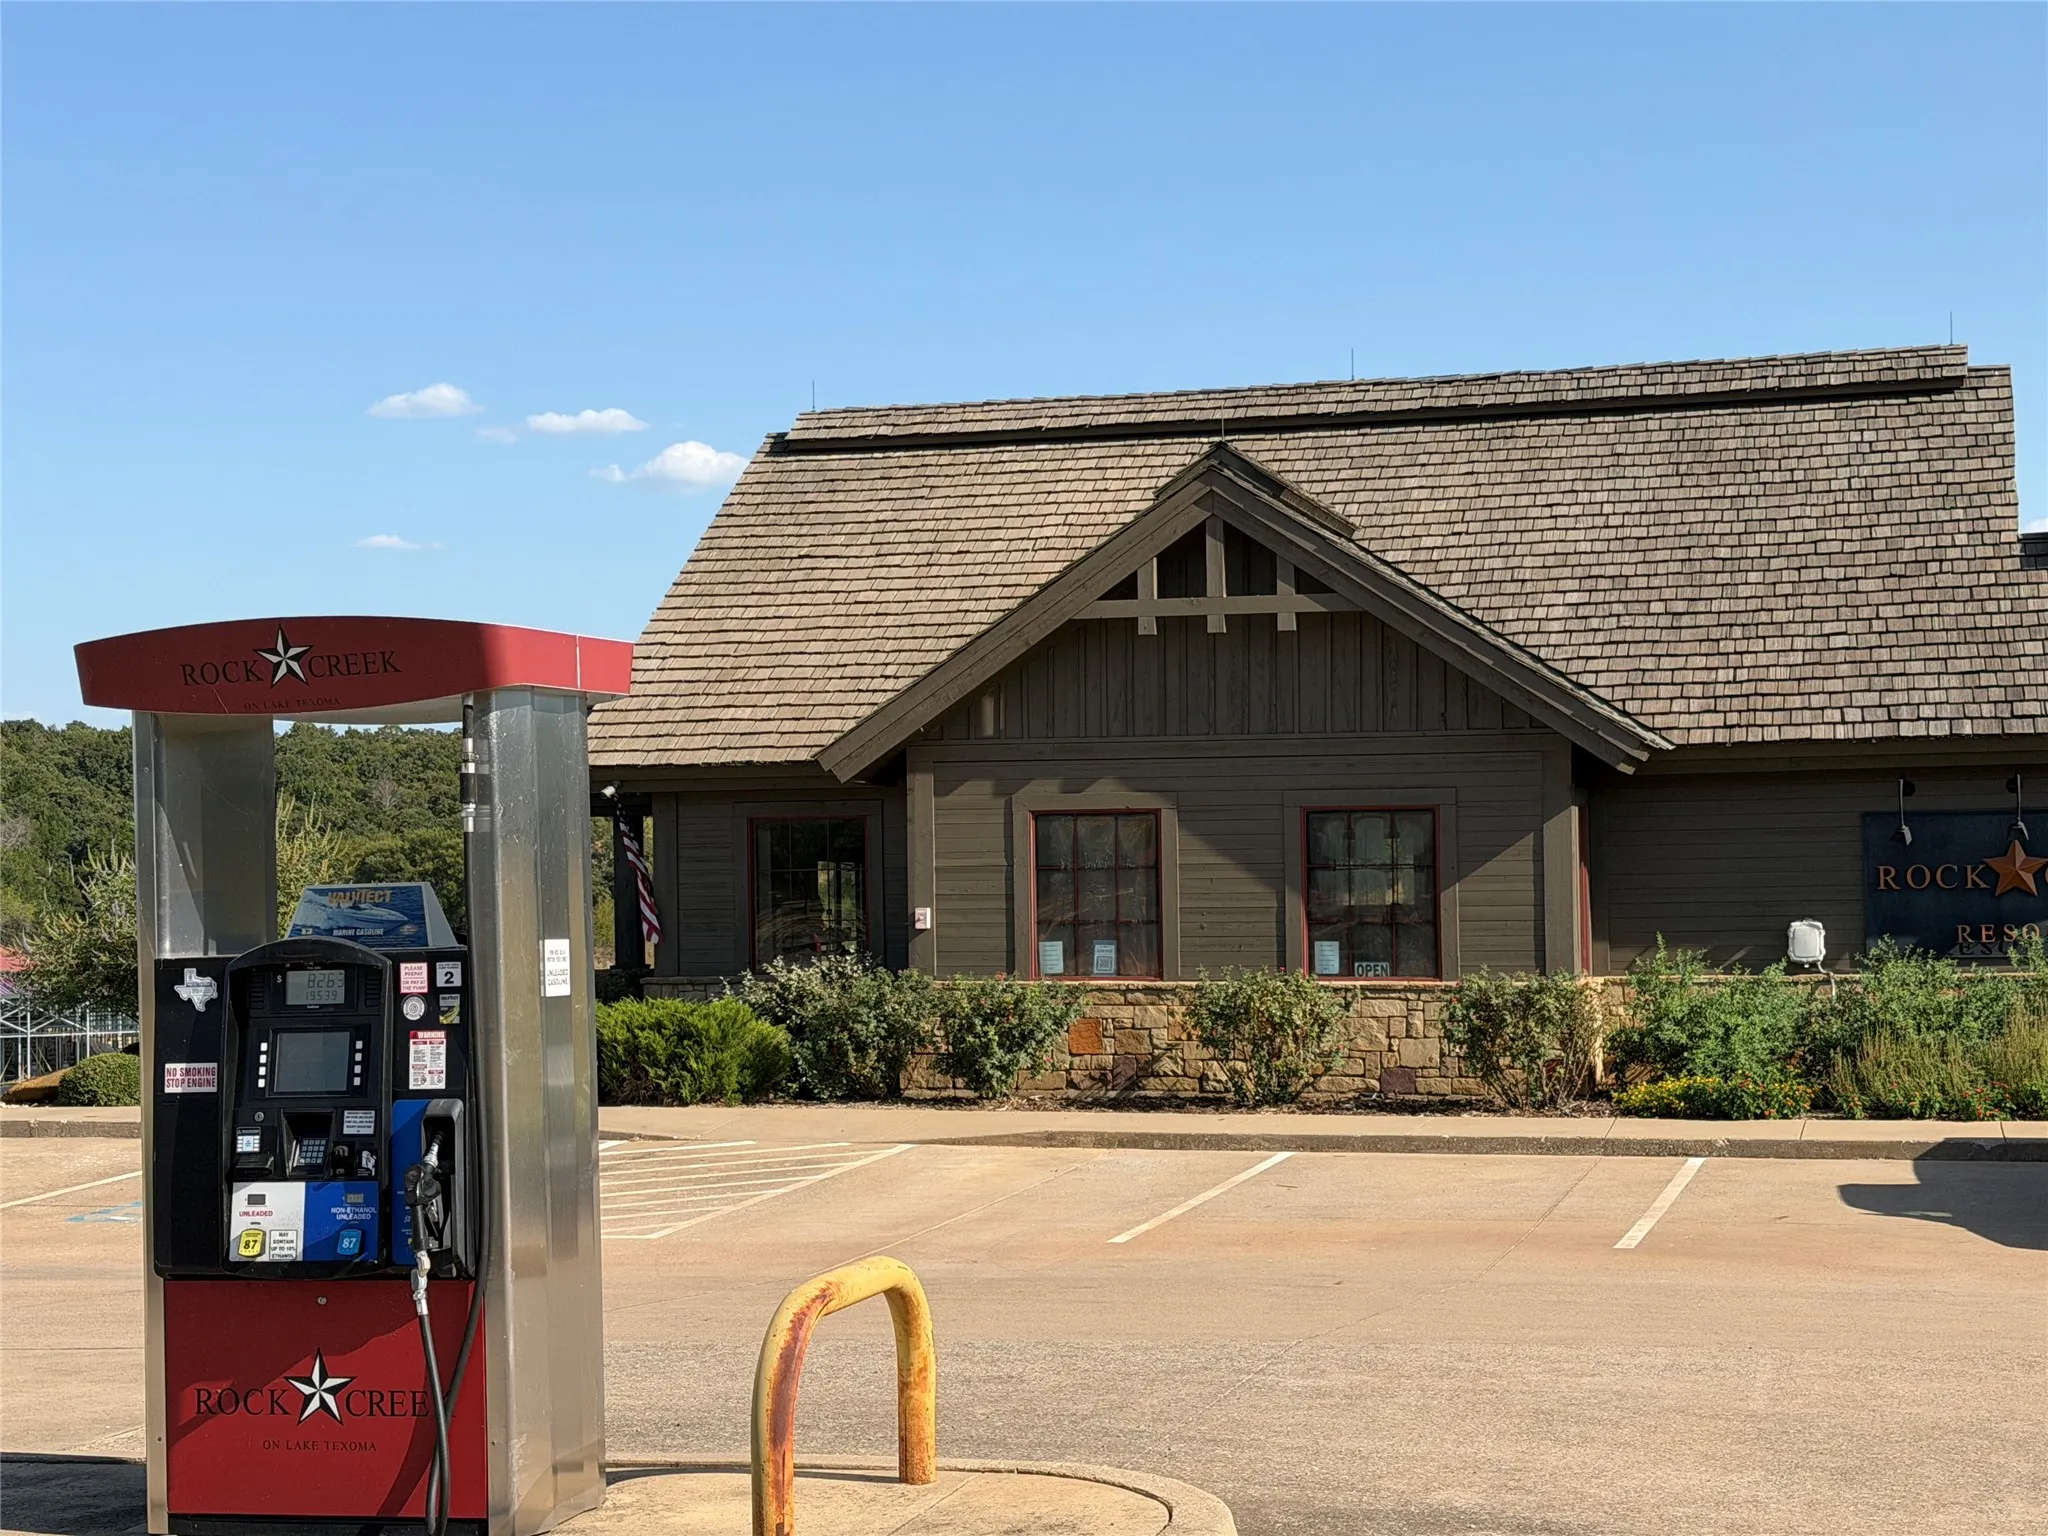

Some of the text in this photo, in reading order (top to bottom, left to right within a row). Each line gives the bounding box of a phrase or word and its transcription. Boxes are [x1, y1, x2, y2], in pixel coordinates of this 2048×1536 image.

[180, 650, 402, 686] ROCK CREEK
[244, 697, 341, 710] ON LAKE TEXOMA
[1876, 864, 1991, 890] ROCK
[1956, 923, 2041, 943] RESO
[1356, 963, 1388, 977] OPEN
[444, 971, 454, 984] 2
[418, 1031, 445, 1039] WARNING
[166, 1067, 216, 1077] NO SMOKING
[166, 1078, 216, 1088] STOP ENGINE
[331, 1206, 377, 1214] NON-ETHANOL
[243, 1239, 258, 1250] 87
[342, 1237, 357, 1249] 87
[195, 1388, 456, 1417] ROCK CREE
[263, 1439, 377, 1451] ON LAKE TEXOMA
